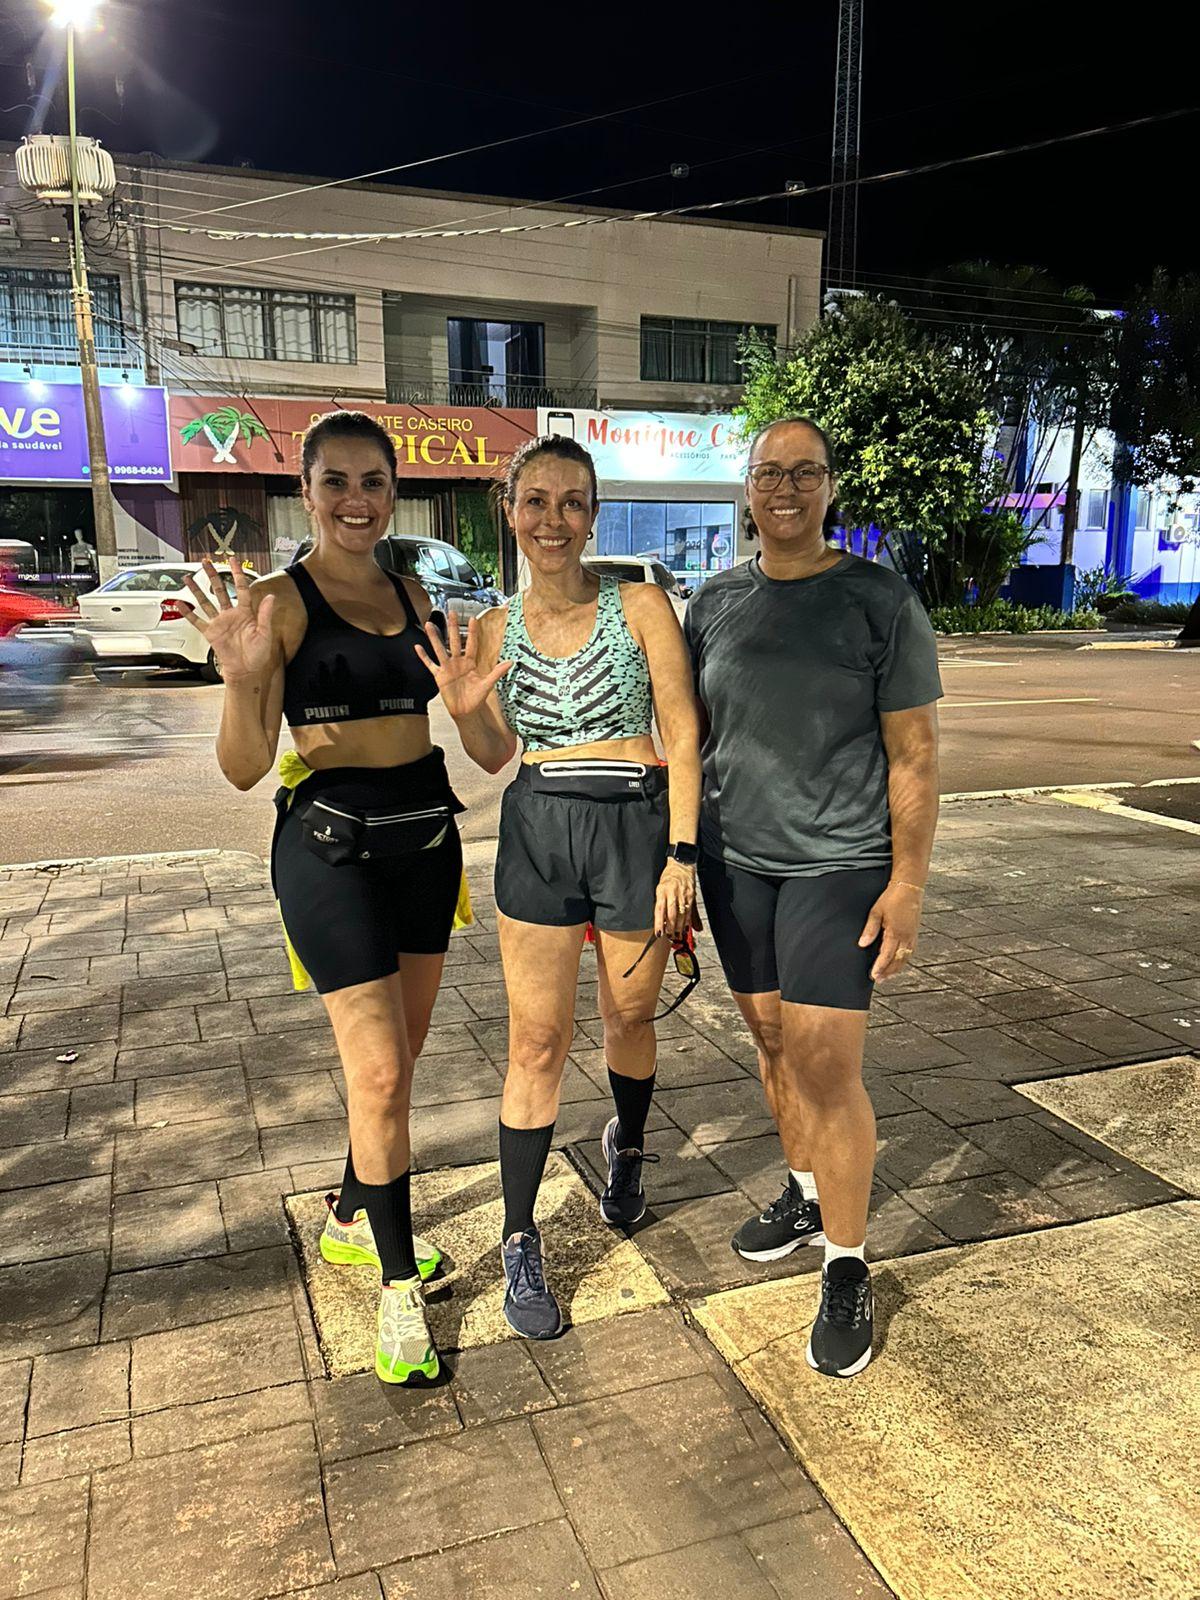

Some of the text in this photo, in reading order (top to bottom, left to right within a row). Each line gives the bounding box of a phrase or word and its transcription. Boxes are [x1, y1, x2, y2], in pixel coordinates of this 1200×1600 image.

[407, 417, 473, 431] CASEIRO
[12, 440, 63, 450] saudável
[588, 418, 702, 456] Monique
[292, 431, 499, 466] TPICAL
[670, 451, 710, 460] ACESSÓRIOS
[304, 698, 415, 720] PUMA PUMA
